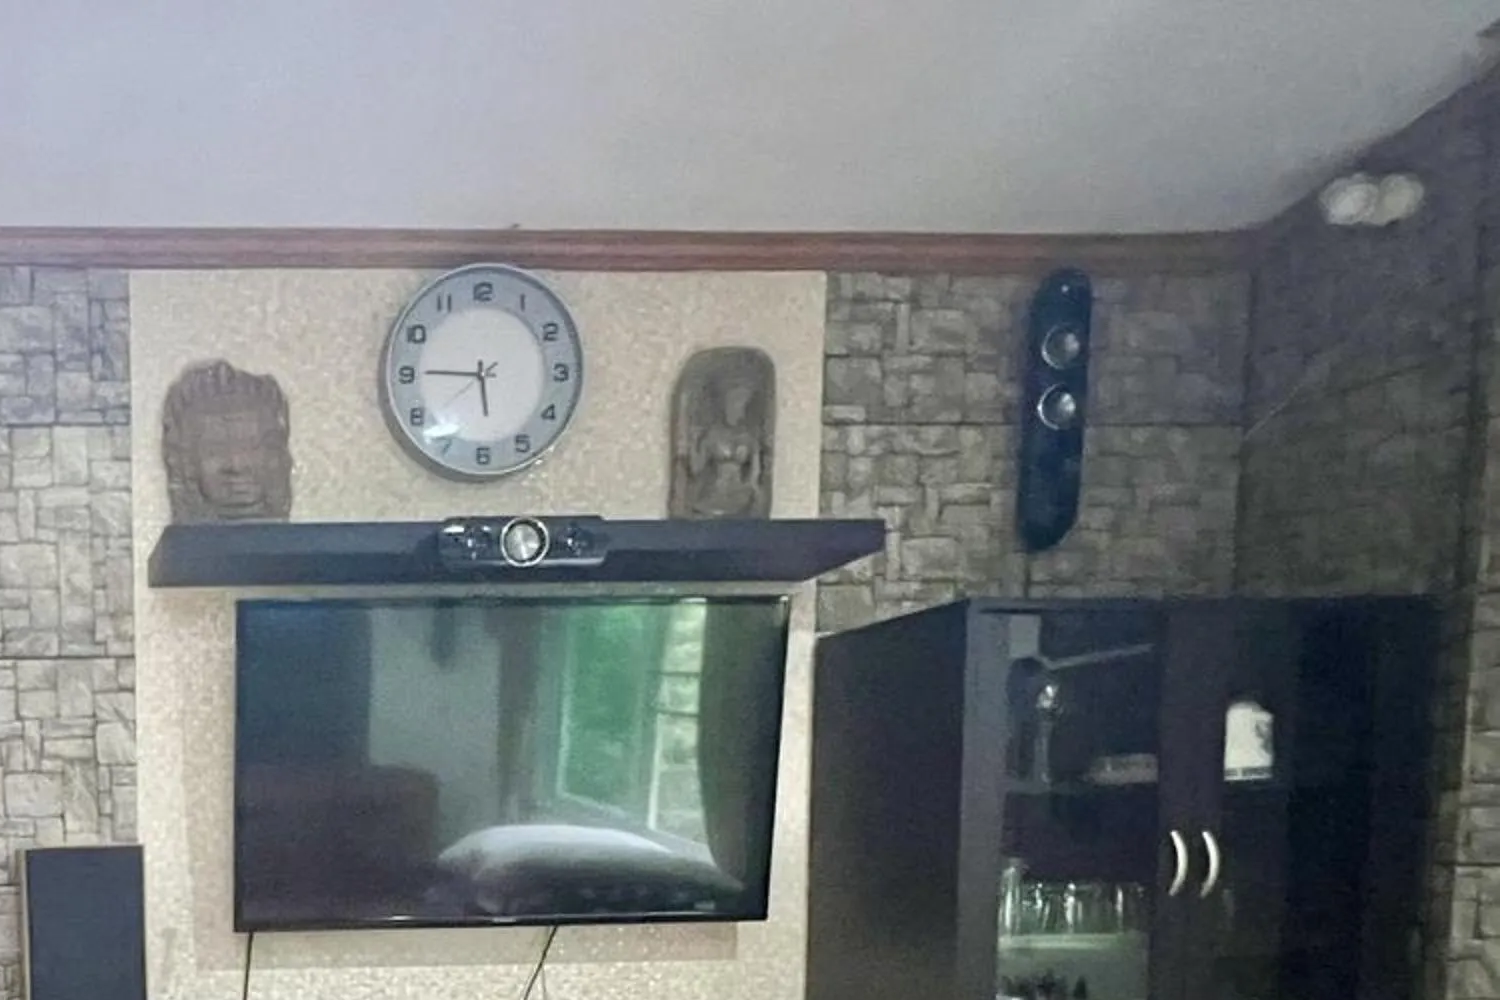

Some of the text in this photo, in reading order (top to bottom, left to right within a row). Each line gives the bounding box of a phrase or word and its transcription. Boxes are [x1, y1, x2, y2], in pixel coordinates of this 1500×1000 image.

[473, 282, 493, 302] 12
[436, 293, 452, 313] 11
[519, 293, 526, 312] 1
[406, 324, 426, 344] 10
[542, 322, 558, 342] 2
[398, 365, 415, 384] 9
[553, 363, 569, 382] 3
[410, 406, 424, 426] 8
[541, 404, 556, 421] 4
[515, 434, 530, 452] 5
[475, 446, 491, 465] 6
